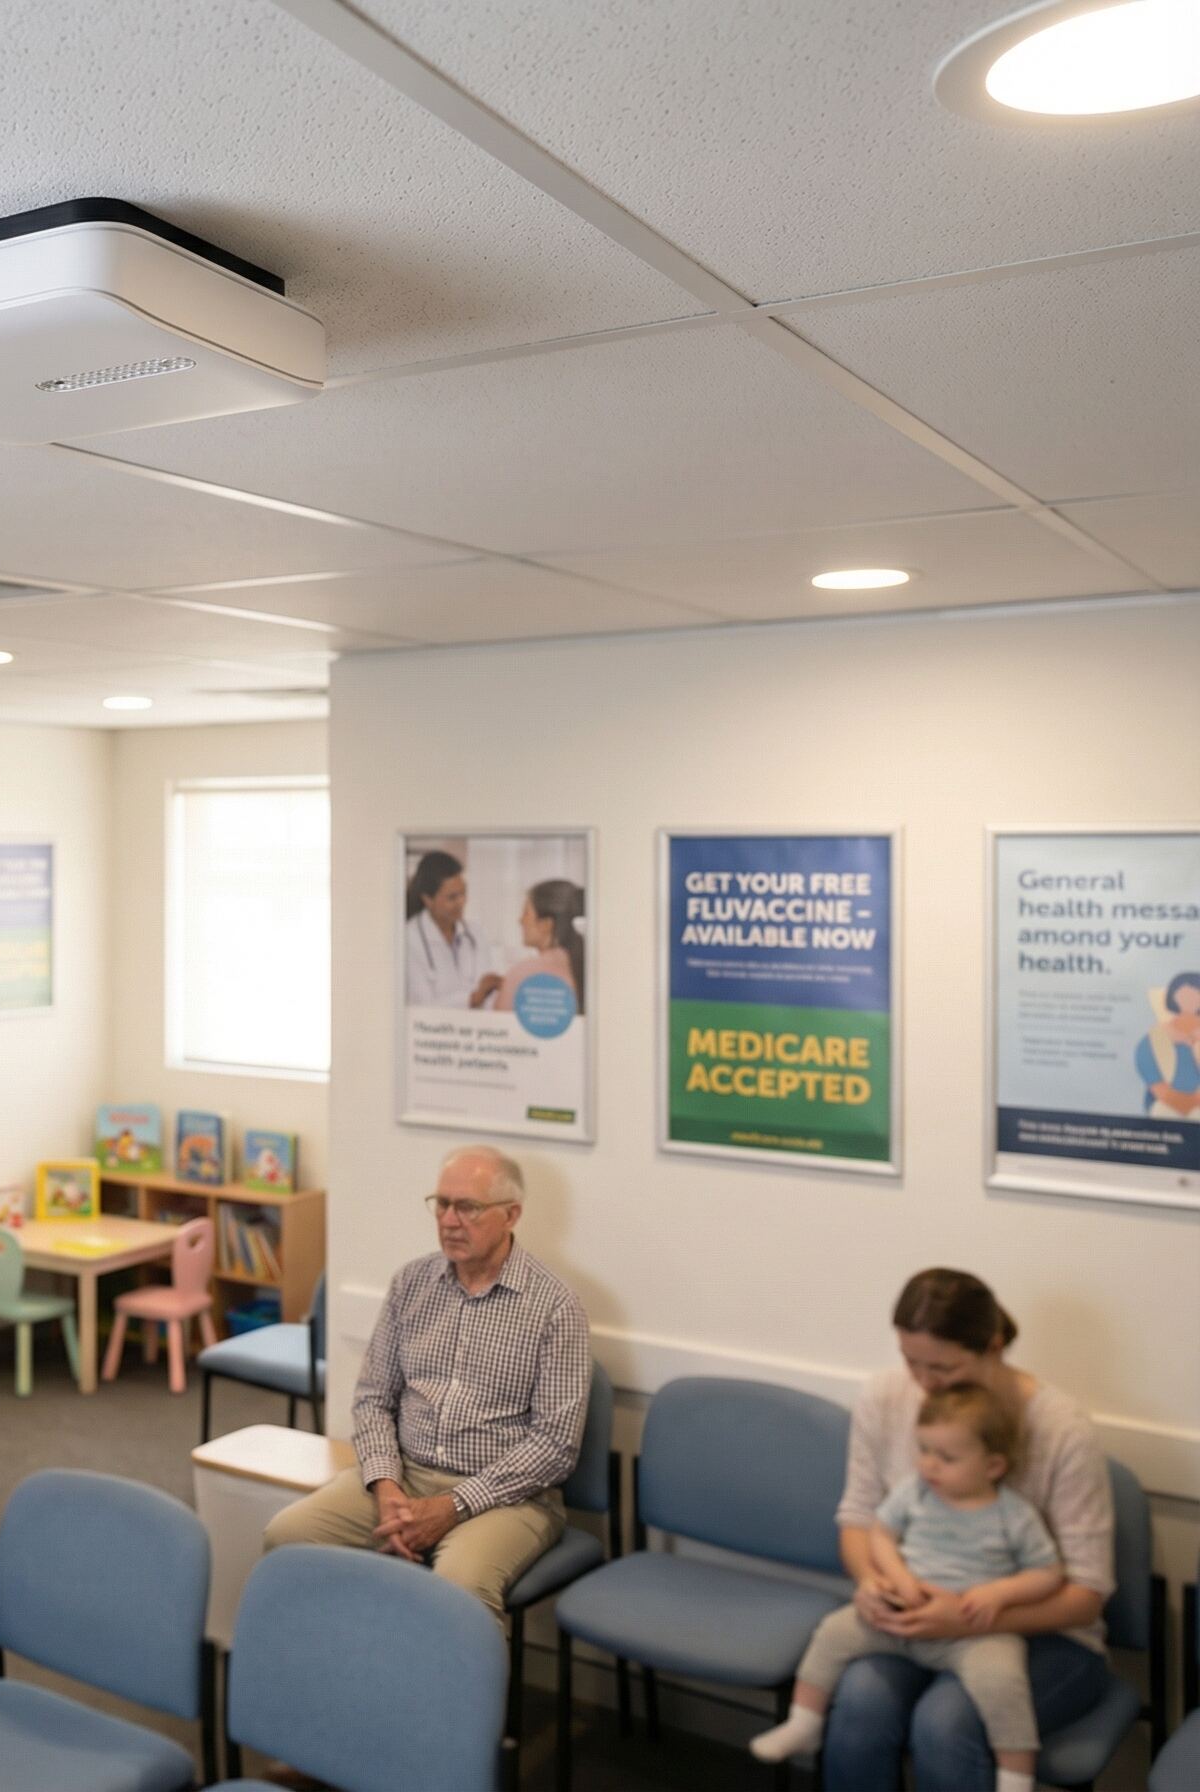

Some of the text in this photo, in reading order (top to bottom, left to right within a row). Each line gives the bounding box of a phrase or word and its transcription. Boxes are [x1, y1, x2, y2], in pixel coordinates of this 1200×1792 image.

[685, 871, 872, 896] GET YOUR FREE
[1018, 870, 1125, 890] General
[687, 898, 853, 923] FLUVACCINE
[1018, 897, 1104, 918] health
[681, 924, 877, 950] AVAILABLE NOW
[1119, 931, 1184, 952] your
[1018, 952, 1112, 974] health.
[687, 1028, 871, 1069] MEDICARE
[686, 1063, 872, 1106] ACCEPTED
